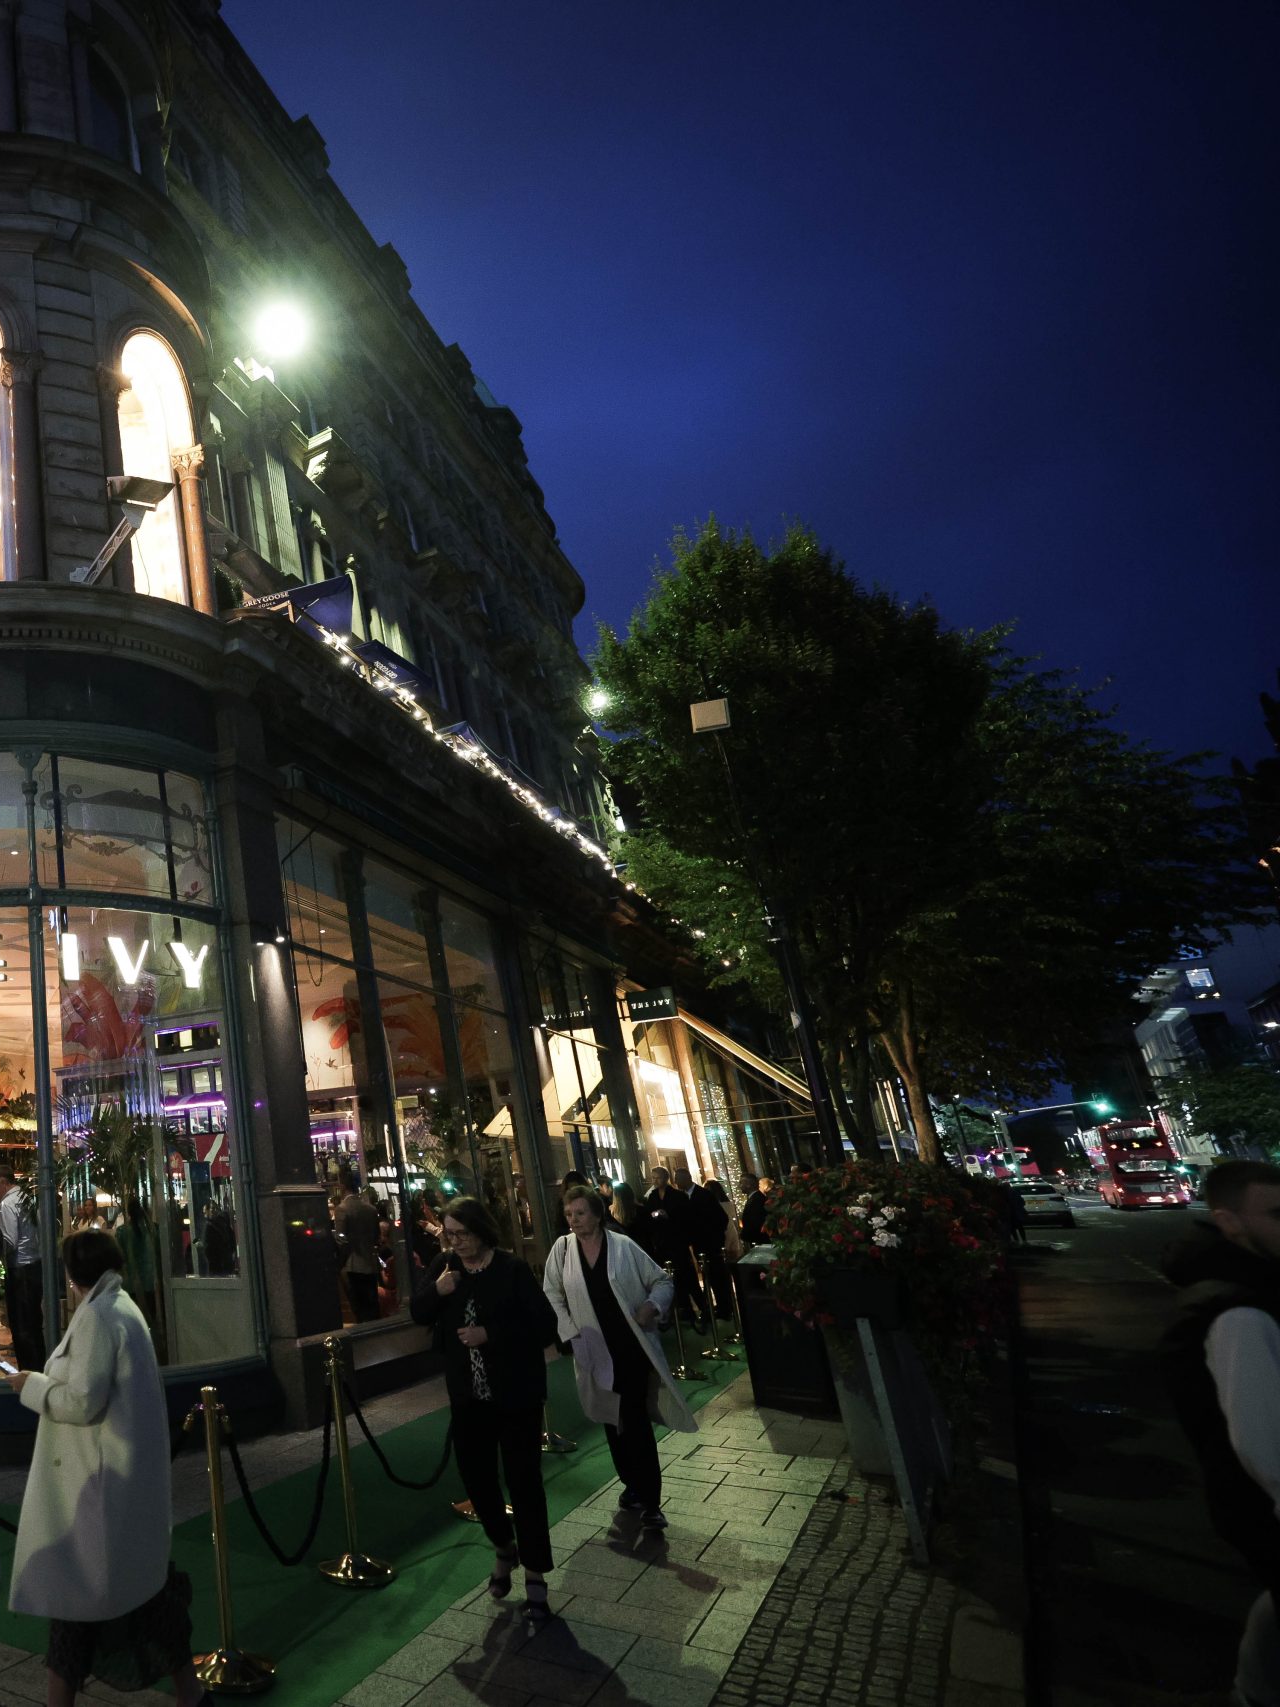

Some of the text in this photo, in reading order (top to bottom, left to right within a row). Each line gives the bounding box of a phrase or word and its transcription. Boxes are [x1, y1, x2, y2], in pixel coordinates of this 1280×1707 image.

[242, 591, 290, 608] GREY GOOSE
[61, 933, 208, 989] IVY
